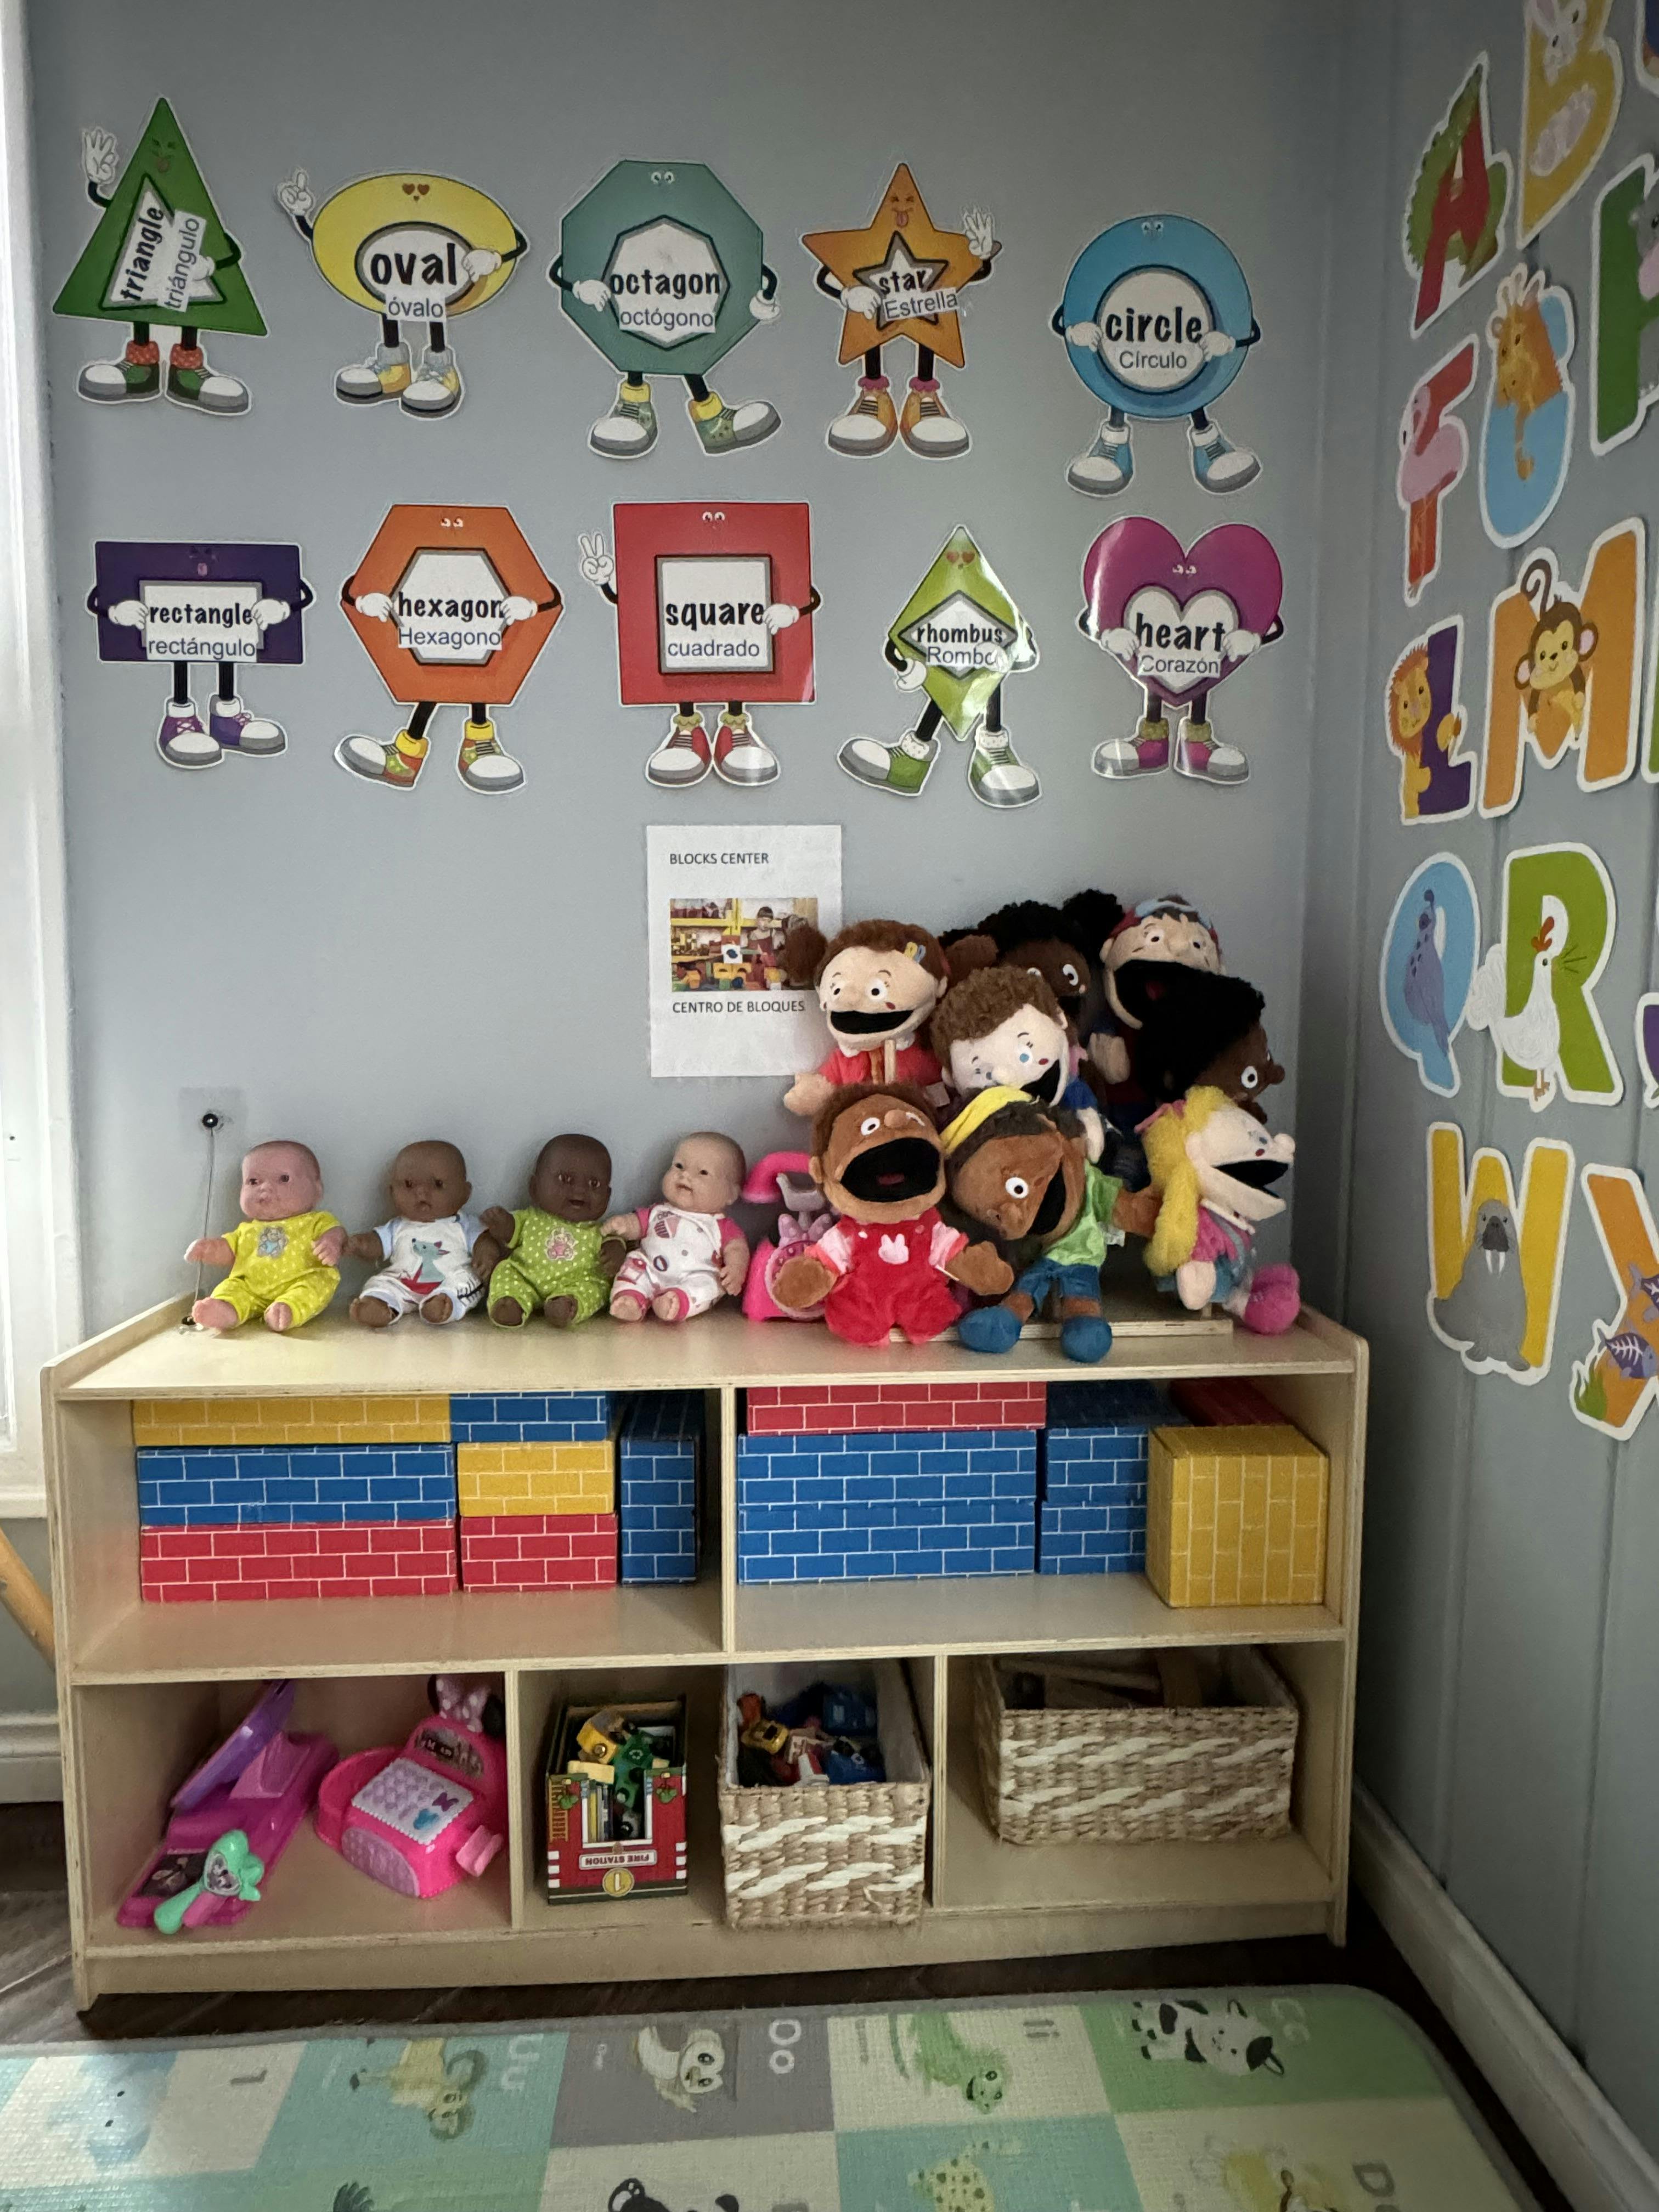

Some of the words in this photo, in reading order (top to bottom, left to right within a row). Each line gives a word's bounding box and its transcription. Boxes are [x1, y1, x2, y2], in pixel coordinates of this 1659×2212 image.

[120, 207, 164, 301] triangle
[164, 218, 200, 309] triángulo
[370, 242, 458, 286] oval
[609, 269, 721, 300] octagon
[878, 270, 927, 295] star
[388, 296, 444, 318] óvalo
[884, 291, 958, 319] Estrella
[620, 308, 714, 331] octógono
[1105, 306, 1204, 343] circle
[1119, 351, 1187, 369] Círculo
[149, 602, 253, 629] rectangle
[398, 591, 506, 623] hexagon
[665, 602, 764, 631] square
[398, 627, 501, 650] Hexagono
[916, 623, 1003, 644] rhombus
[1136, 612, 1226, 652] heart
[148, 637, 256, 660] rectángulo
[668, 639, 760, 657] cuadrado
[1138, 654, 1219, 674] Corazón
[1484, 529, 1639, 813] M
[669, 853, 718, 865] BLOCKS
[720, 853, 769, 865] CENTER
[1502, 853, 1622, 1096] R
[672, 1002, 723, 1014] CENTRO
[727, 1001, 743, 1013] DE
[747, 1001, 805, 1013] BLOQUES
[1431, 1128, 1571, 1369] W
[585, 1855, 625, 1866] STATION
[627, 1854, 650, 1863] FIRE
[614, 1873, 621, 1891] 1
